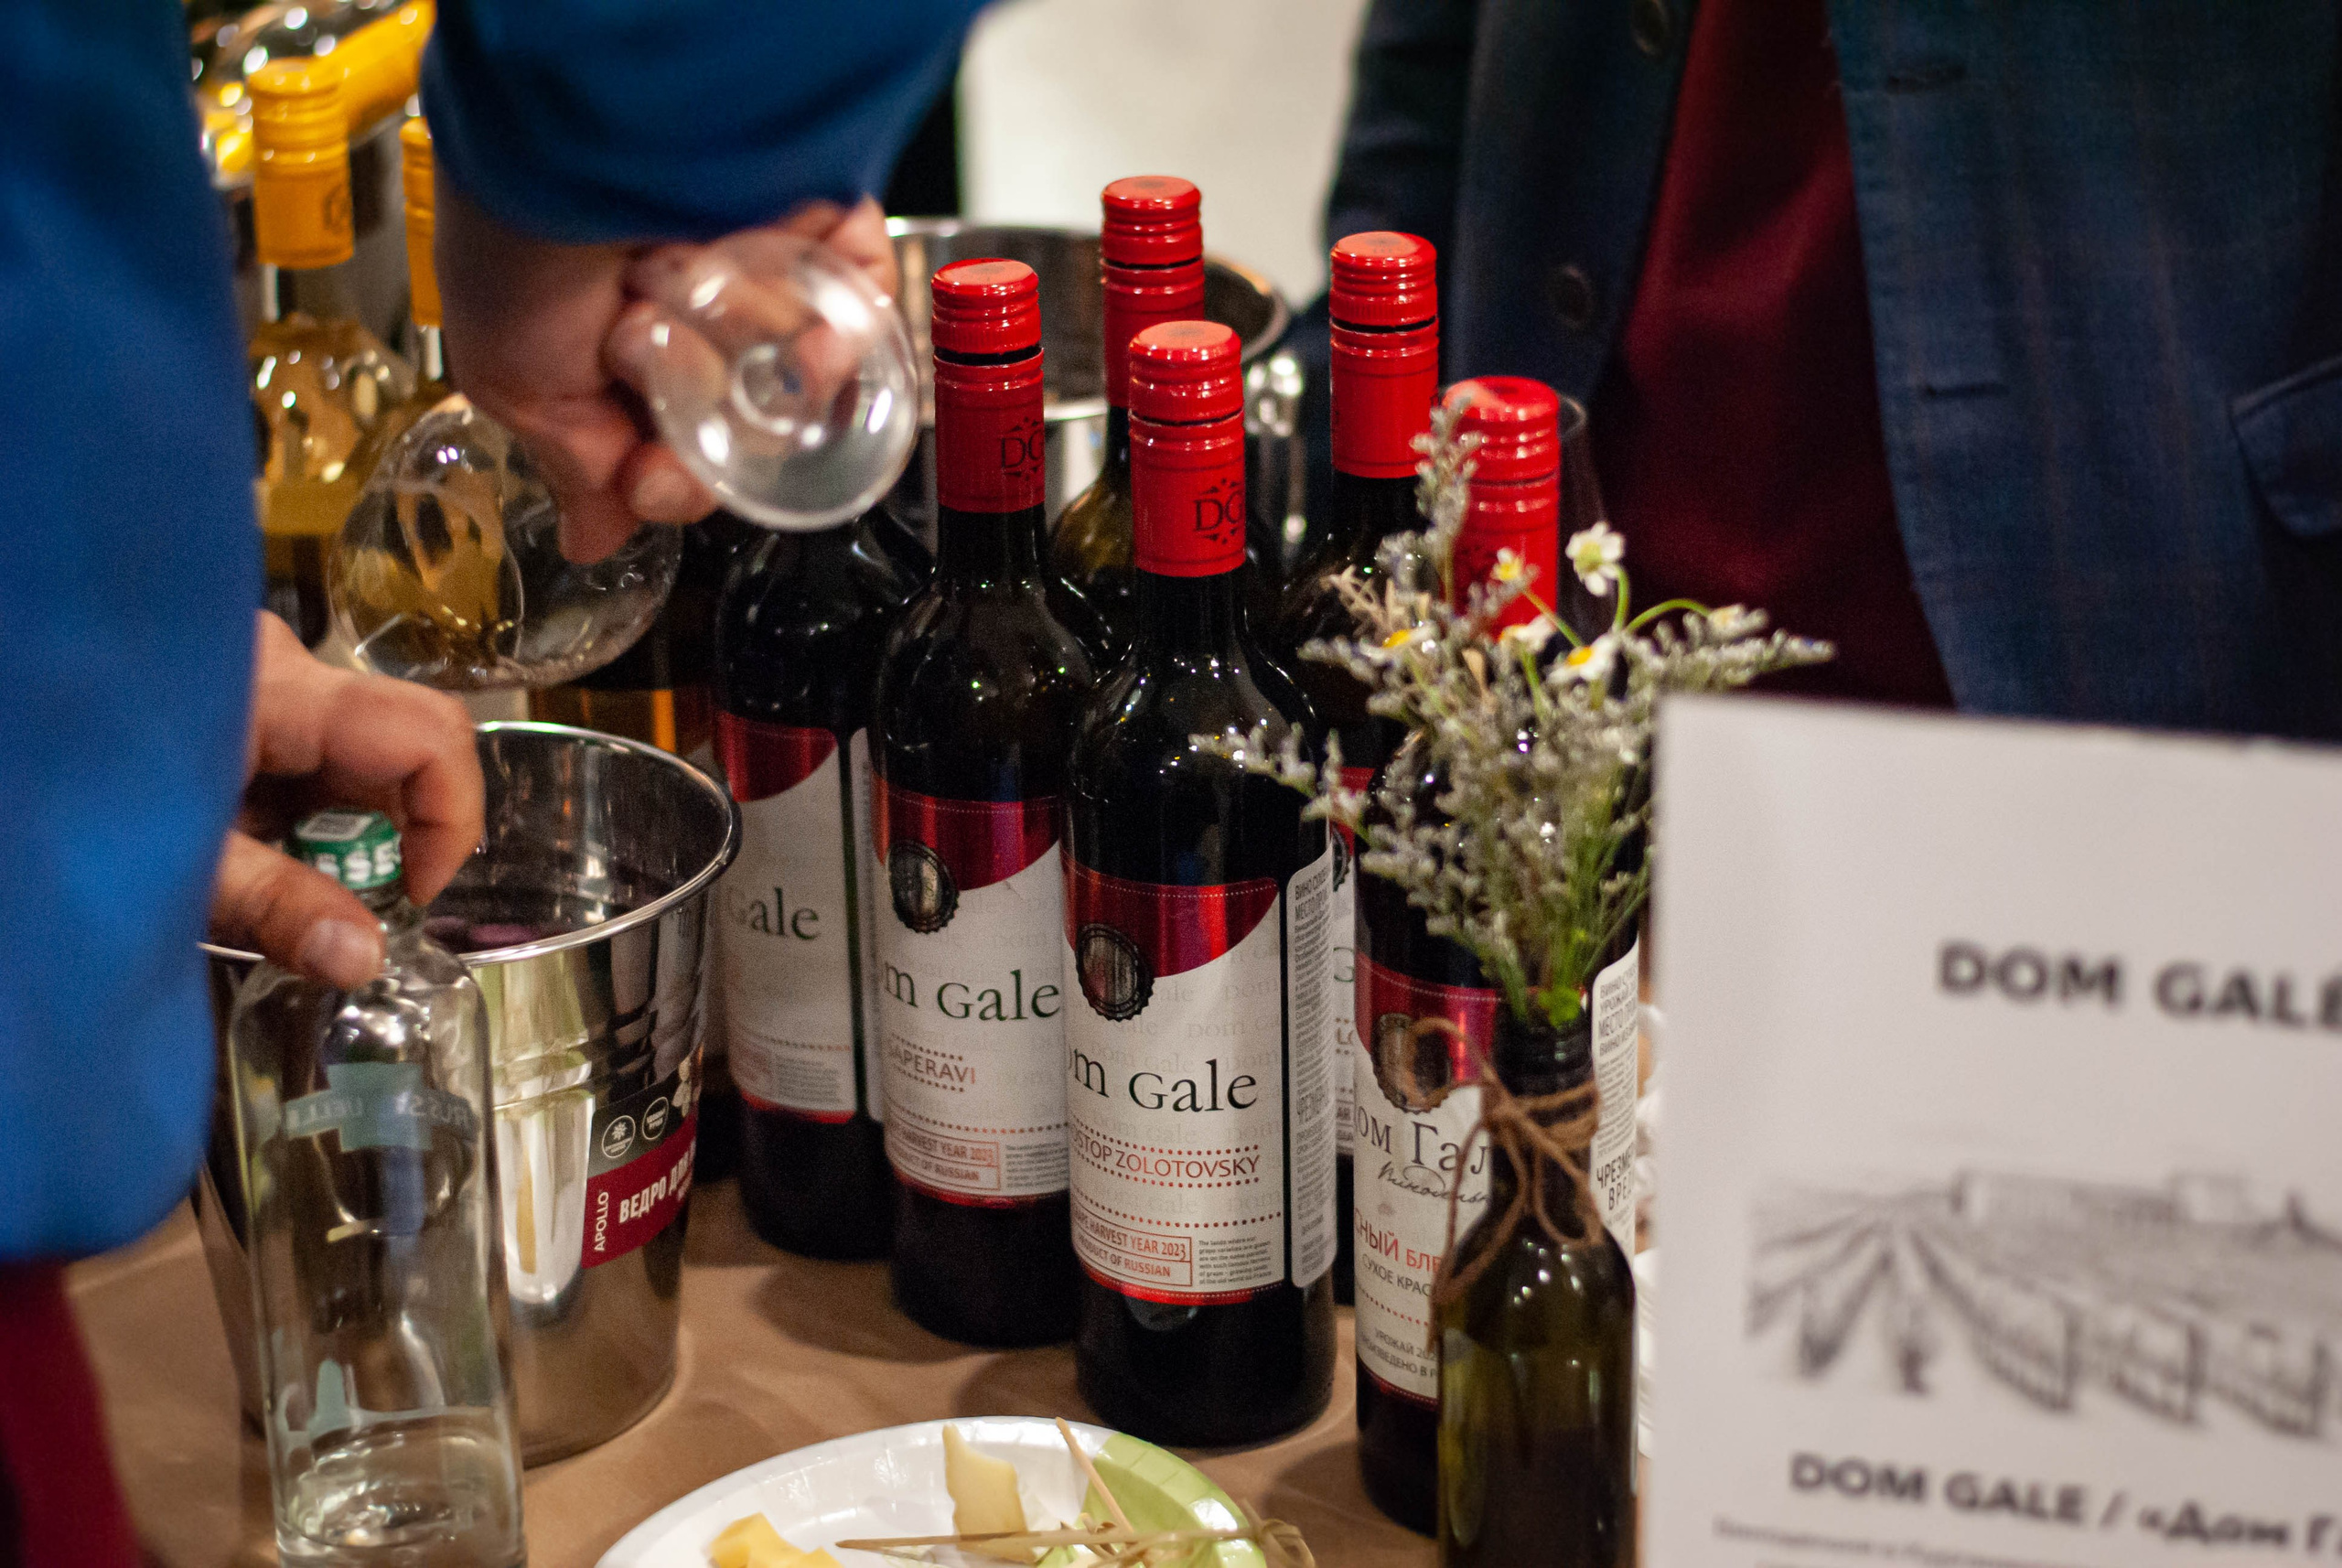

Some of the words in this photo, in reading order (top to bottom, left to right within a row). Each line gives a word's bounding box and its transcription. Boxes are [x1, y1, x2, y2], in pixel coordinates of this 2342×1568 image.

[1937, 939, 2123, 1007] DOM
[937, 970, 1061, 1021] Gale
[1128, 1058, 1257, 1112] Gale
[941, 1142, 968, 1159] YEAR
[1116, 1148, 1261, 1178] ZOLOTOVSKY
[619, 1176, 667, 1224] ВЕДРО
[595, 1191, 609, 1252] APOLLO
[1090, 1220, 1128, 1248] HARVEST
[1130, 1235, 1159, 1255] YEAR
[1161, 1241, 1187, 1262] 2023
[1110, 1253, 1122, 1265] OF
[1124, 1258, 1171, 1277] RUSSIAN
[1362, 1253, 1393, 1284] СУХОЕ
[1375, 1326, 1413, 1355] УРОЖАЙ
[1420, 1366, 1427, 1377] В
[1789, 1452, 1928, 1502] DOM
[1943, 1473, 2089, 1527] GALE
